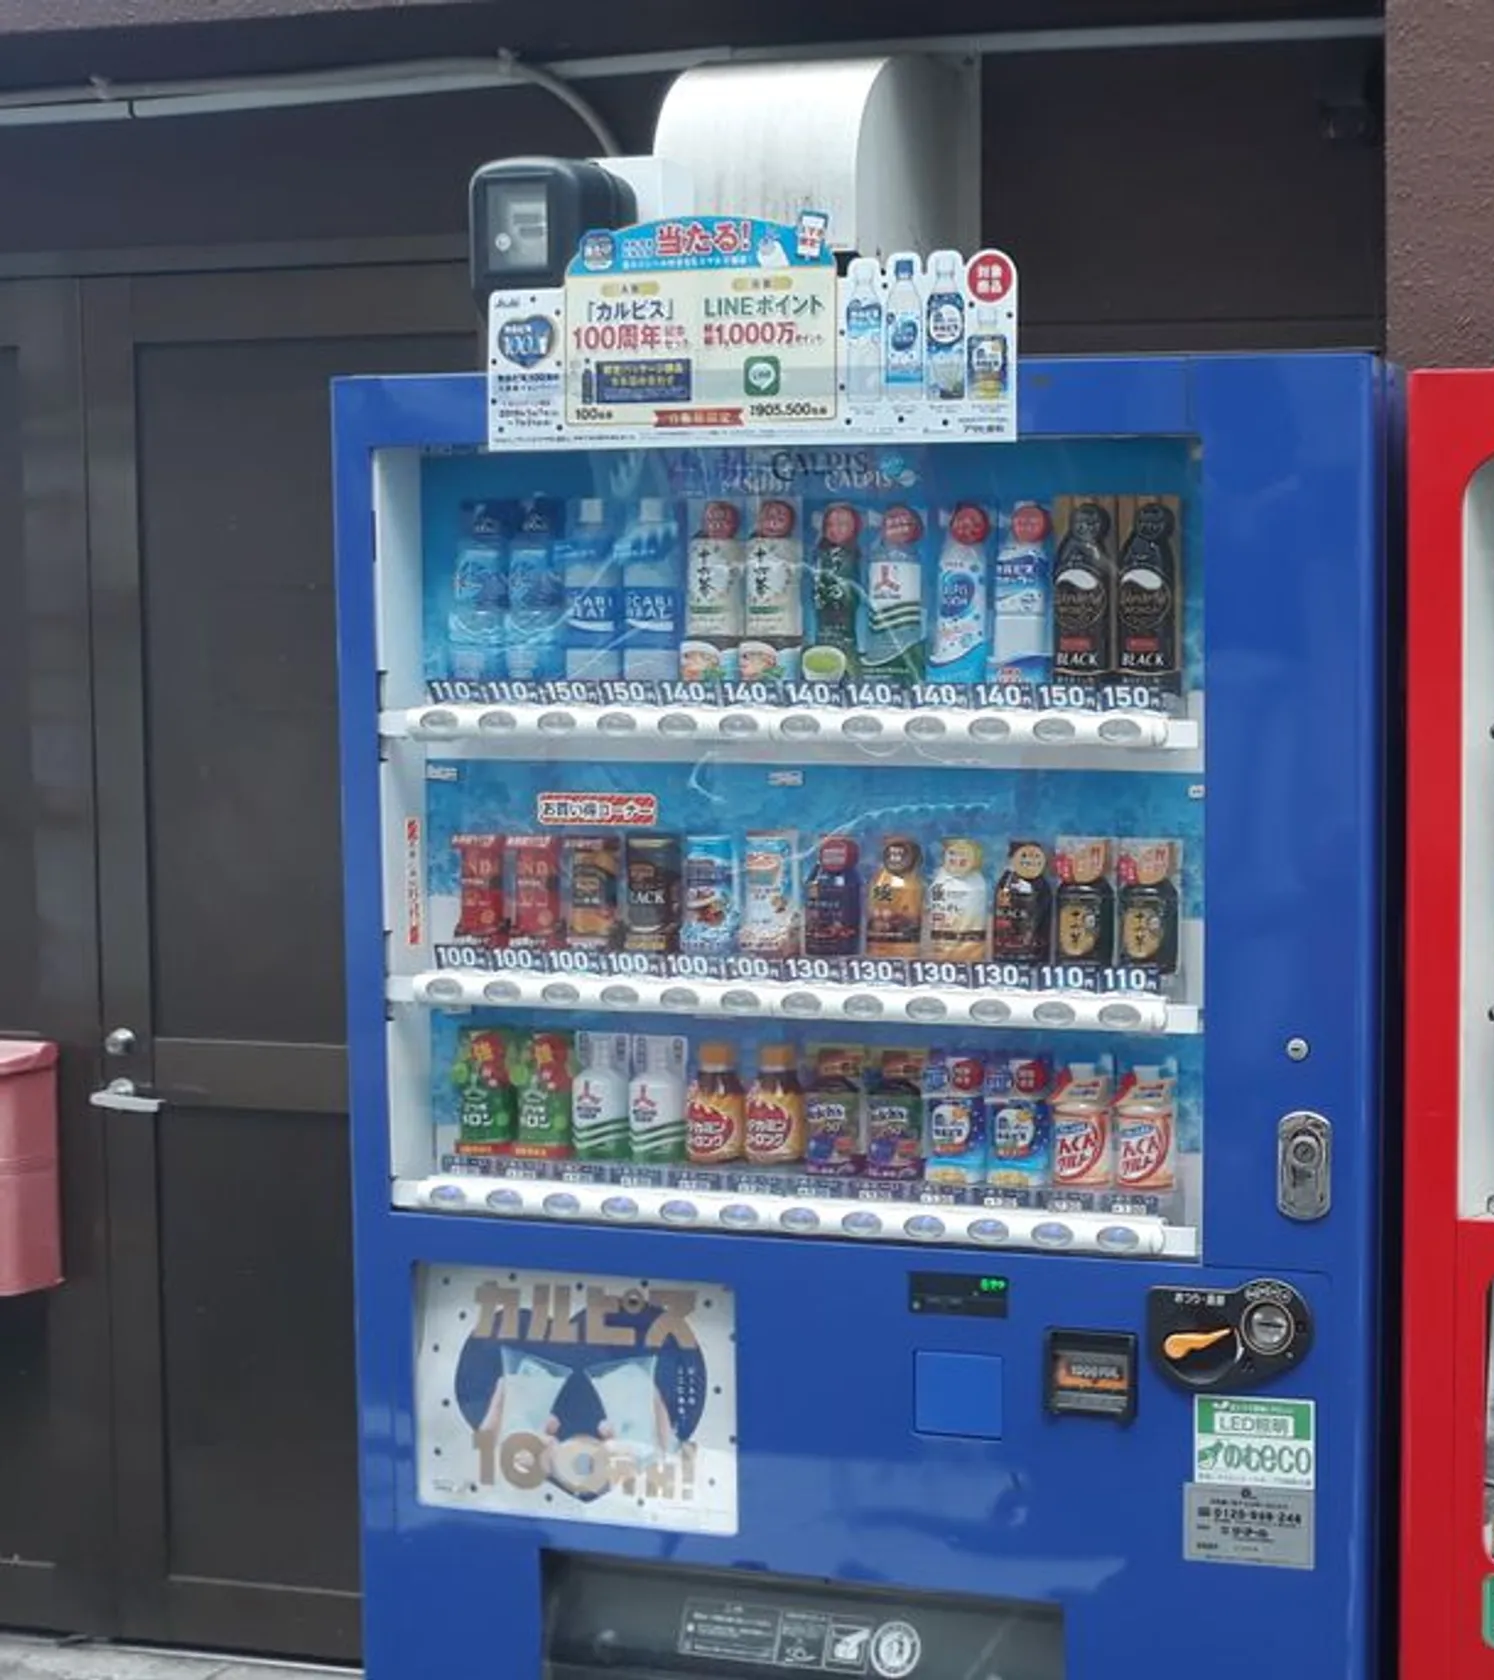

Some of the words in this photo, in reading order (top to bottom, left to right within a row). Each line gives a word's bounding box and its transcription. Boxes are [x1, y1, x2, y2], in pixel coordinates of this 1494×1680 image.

[1056, 652, 1099, 666] BLACK
[1121, 652, 1165, 667] BLACK
[472, 1281, 701, 1349] カルピス
[1218, 1415, 1290, 1436] LED照明
